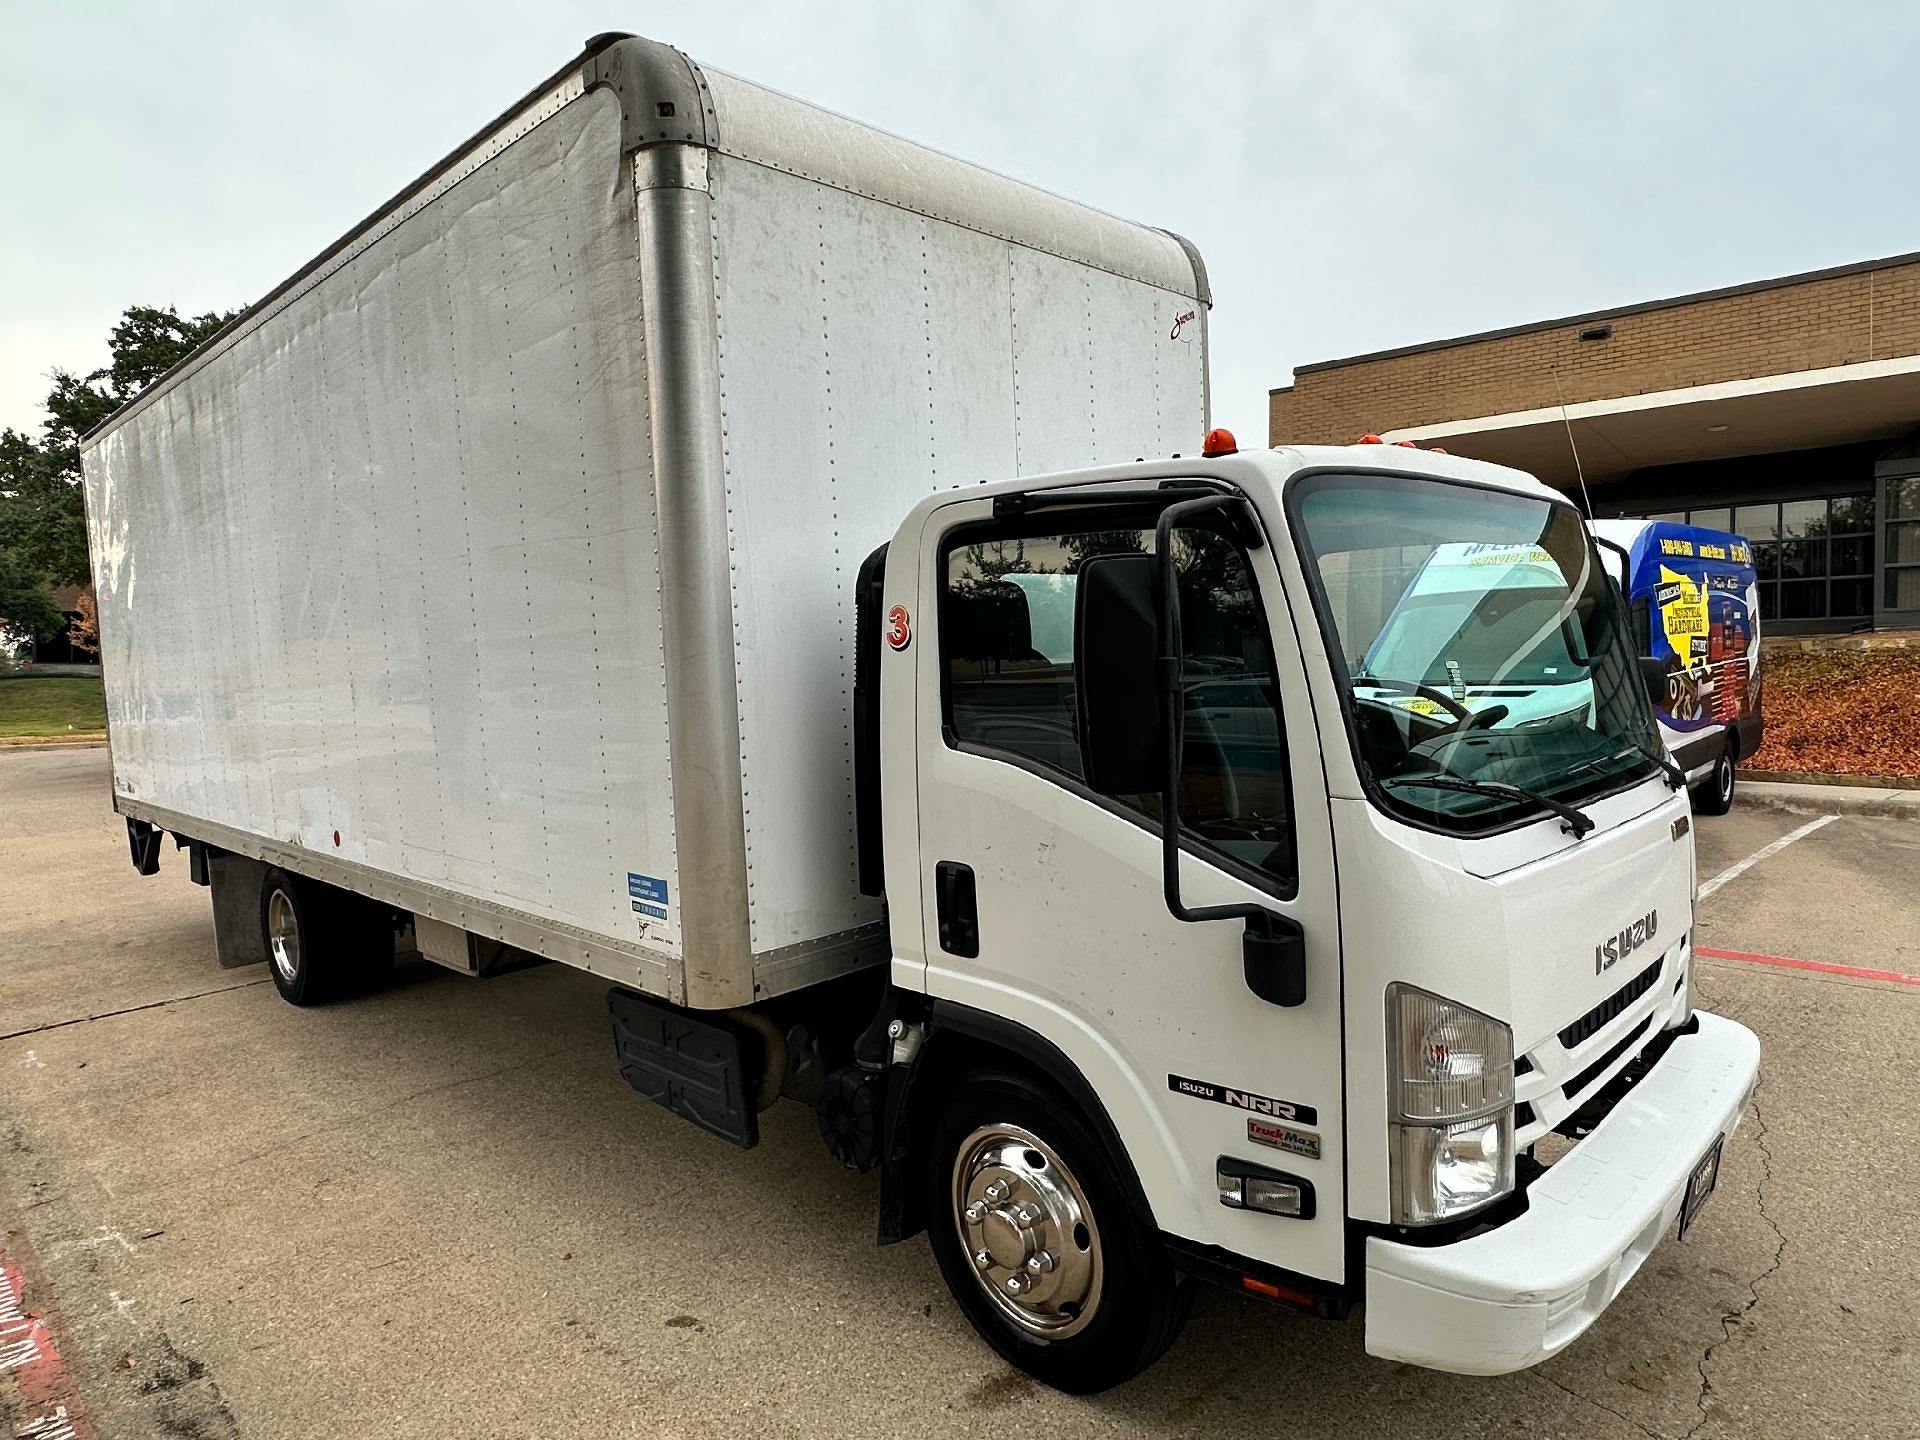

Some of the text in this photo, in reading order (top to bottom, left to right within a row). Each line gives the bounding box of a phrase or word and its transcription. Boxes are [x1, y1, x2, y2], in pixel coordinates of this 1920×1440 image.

[886, 604, 912, 652] 3
[1668, 616, 1703, 635] HARDWARE
[1595, 908, 1658, 976] ISUZU
[1179, 1081, 1296, 1120] ISUZU NRR
